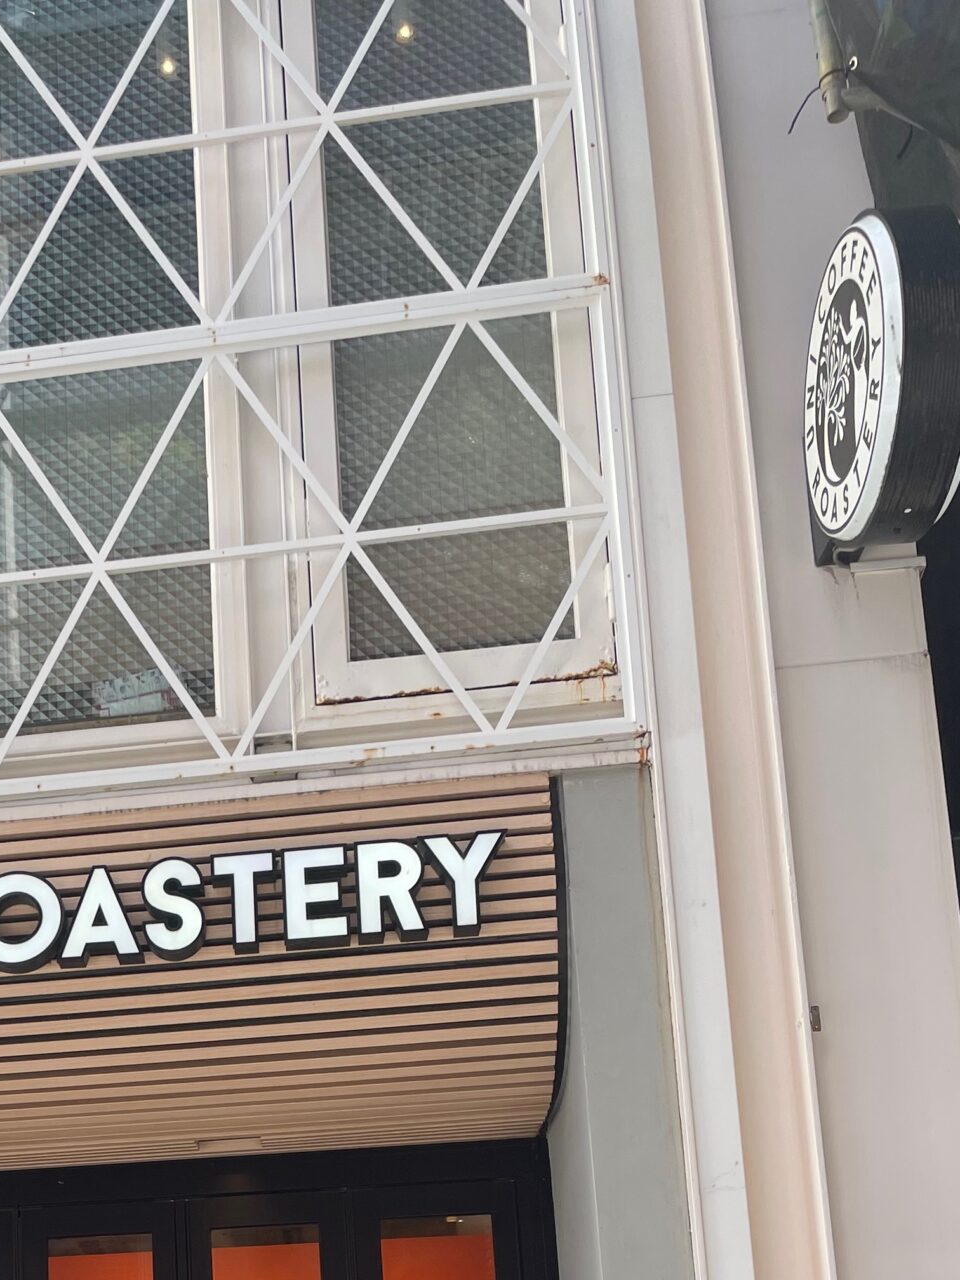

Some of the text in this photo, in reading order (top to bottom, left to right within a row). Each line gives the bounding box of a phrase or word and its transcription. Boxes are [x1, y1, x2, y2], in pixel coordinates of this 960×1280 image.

[806, 240, 882, 524] UNI COFFEE ROASTERY
